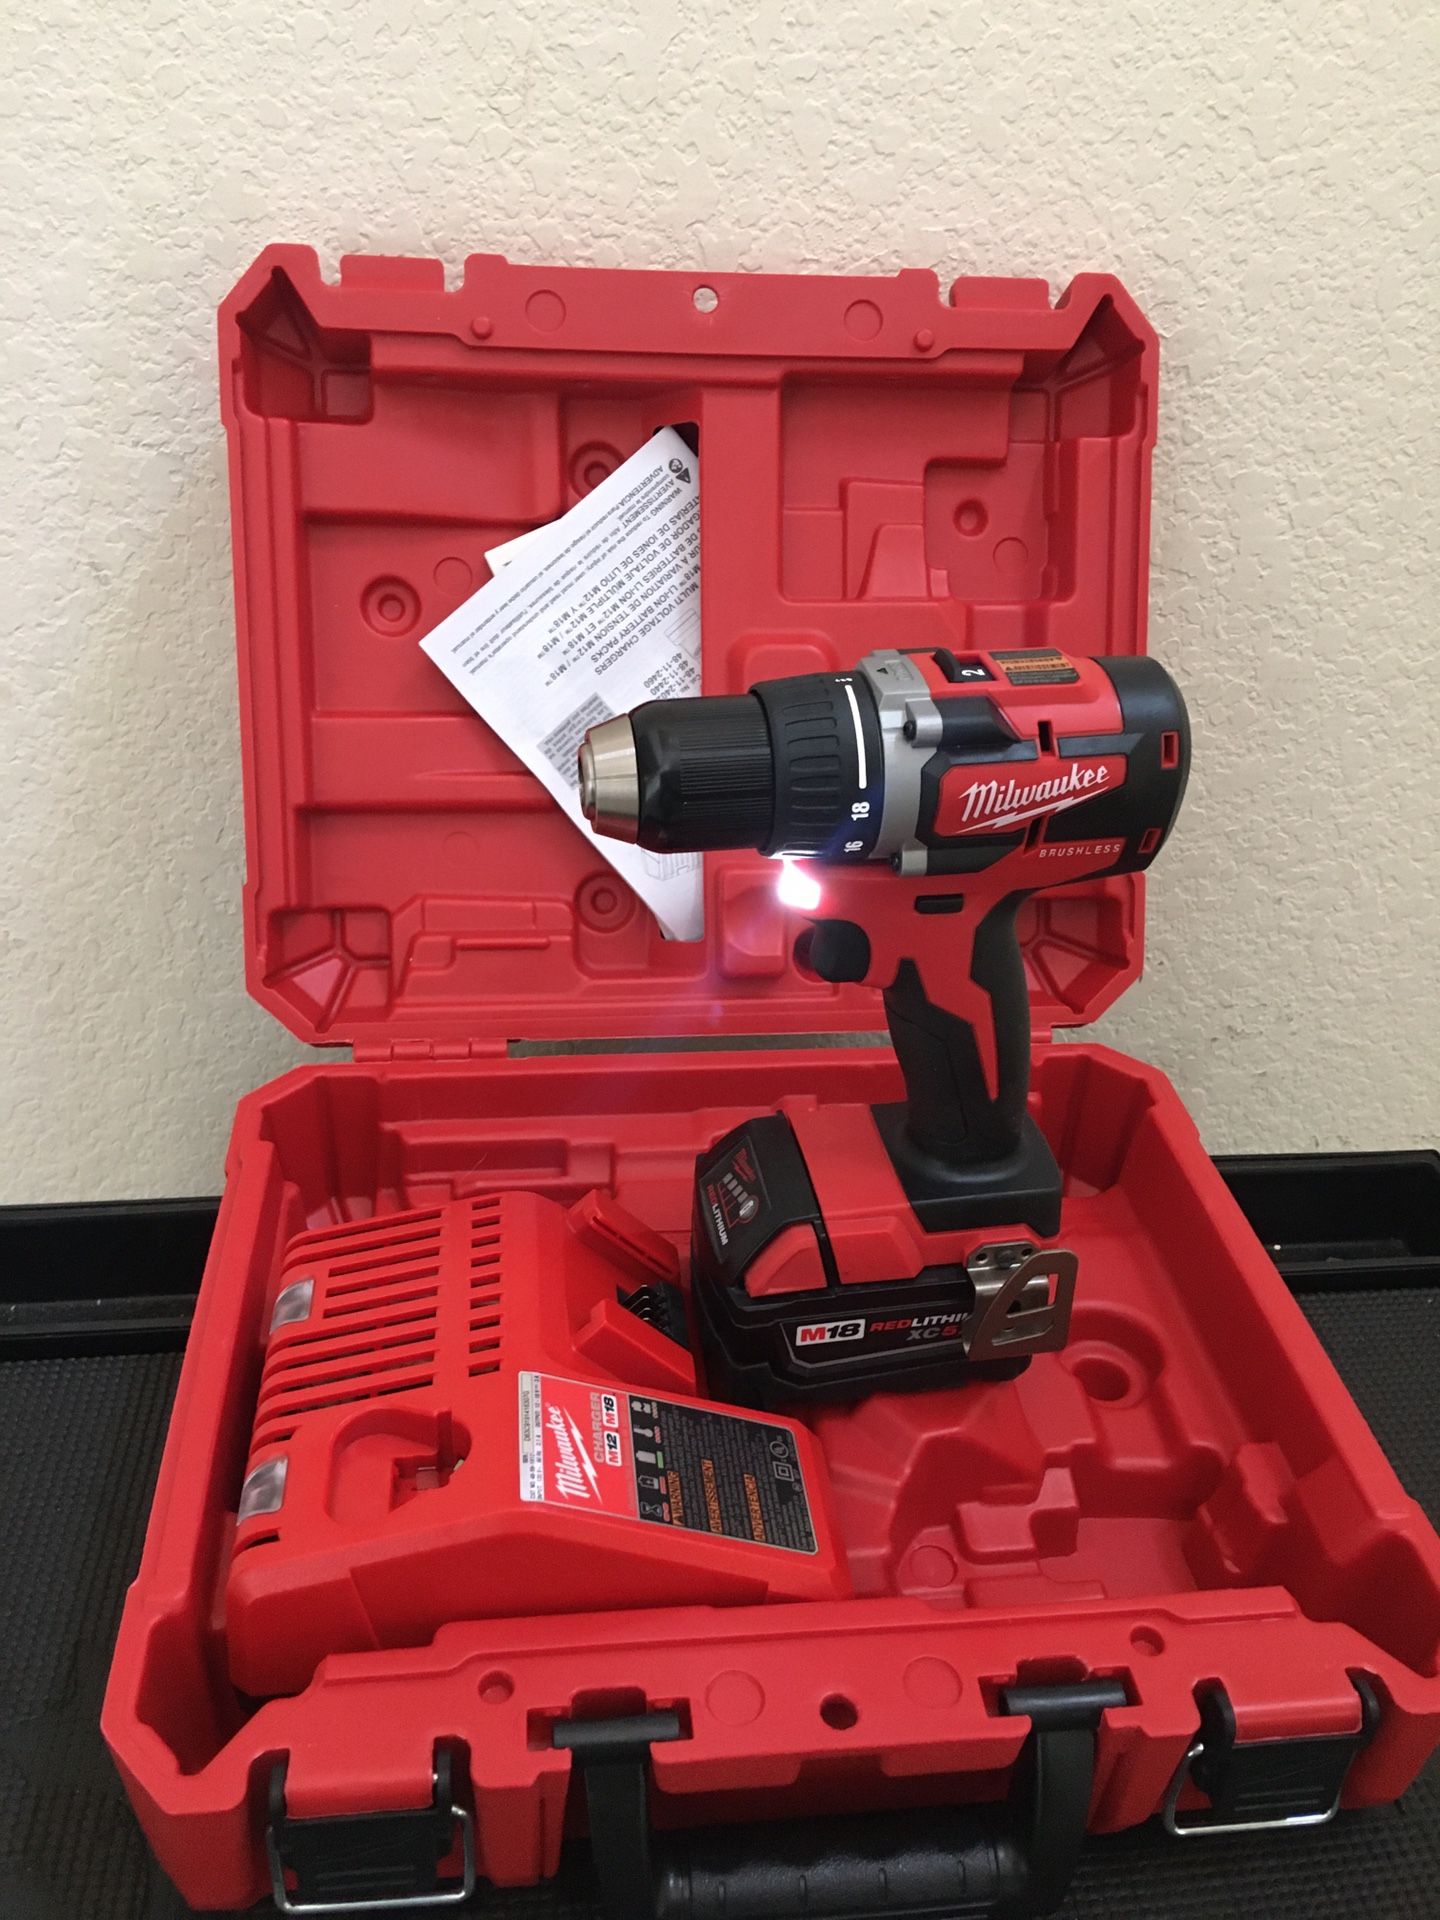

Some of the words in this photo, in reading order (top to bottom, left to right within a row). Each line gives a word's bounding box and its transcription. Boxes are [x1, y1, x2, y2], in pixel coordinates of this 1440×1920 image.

[616, 464, 665, 508] ADVERTENCIA
[649, 486, 683, 517] WARNING
[620, 478, 676, 528] AVERTISSEMENT
[655, 522, 671, 537] DE
[668, 509, 703, 541] GADOR
[683, 531, 699, 546] DE
[631, 533, 659, 558] IONES
[656, 536, 672, 552] DE
[597, 565, 622, 588] LITIO
[618, 554, 634, 569] DE
[622, 547, 661, 582] VOLTAJE
[640, 542, 687, 584] BATTERIES
[616, 580, 644, 605] LI-ION
[639, 562, 683, 601] VARIATION
[651, 583, 679, 608] LI-ION
[672, 580, 700, 606] MULTI
[568, 604, 578, 614] Y
[626, 597, 643, 613] DE
[636, 601, 676, 637] VOLTAGE
[583, 621, 597, 635] ET
[592, 608, 630, 642] TENSION
[616, 604, 655, 640] BATTERY
[589, 635, 620, 664] PACKS
[592, 633, 640, 676] CHARGERS
[641, 650, 684, 689] 48-11-2460
[648, 658, 690, 697] 48-11-2440
[961, 668, 985, 677] 2
[958, 763, 1110, 822] Milwaukee
[851, 801, 870, 821] 18
[844, 840, 863, 853] 16
[1039, 844, 1121, 858] BRUSHLESS
[800, 1322, 861, 1342] M18
[870, 1313, 968, 1332] REDLITHI
[906, 1325, 961, 1341] XC5
[603, 1395, 617, 1427] M18
[590, 1392, 605, 1463] CHARGER
[545, 1404, 591, 1499] Milwaukee
[606, 1432, 620, 1465] M12
[667, 1471, 684, 1515] WARNING
[702, 1459, 722, 1533] AVERTISSEMENT
[744, 1474, 766, 1542] ADVERTENCIA
